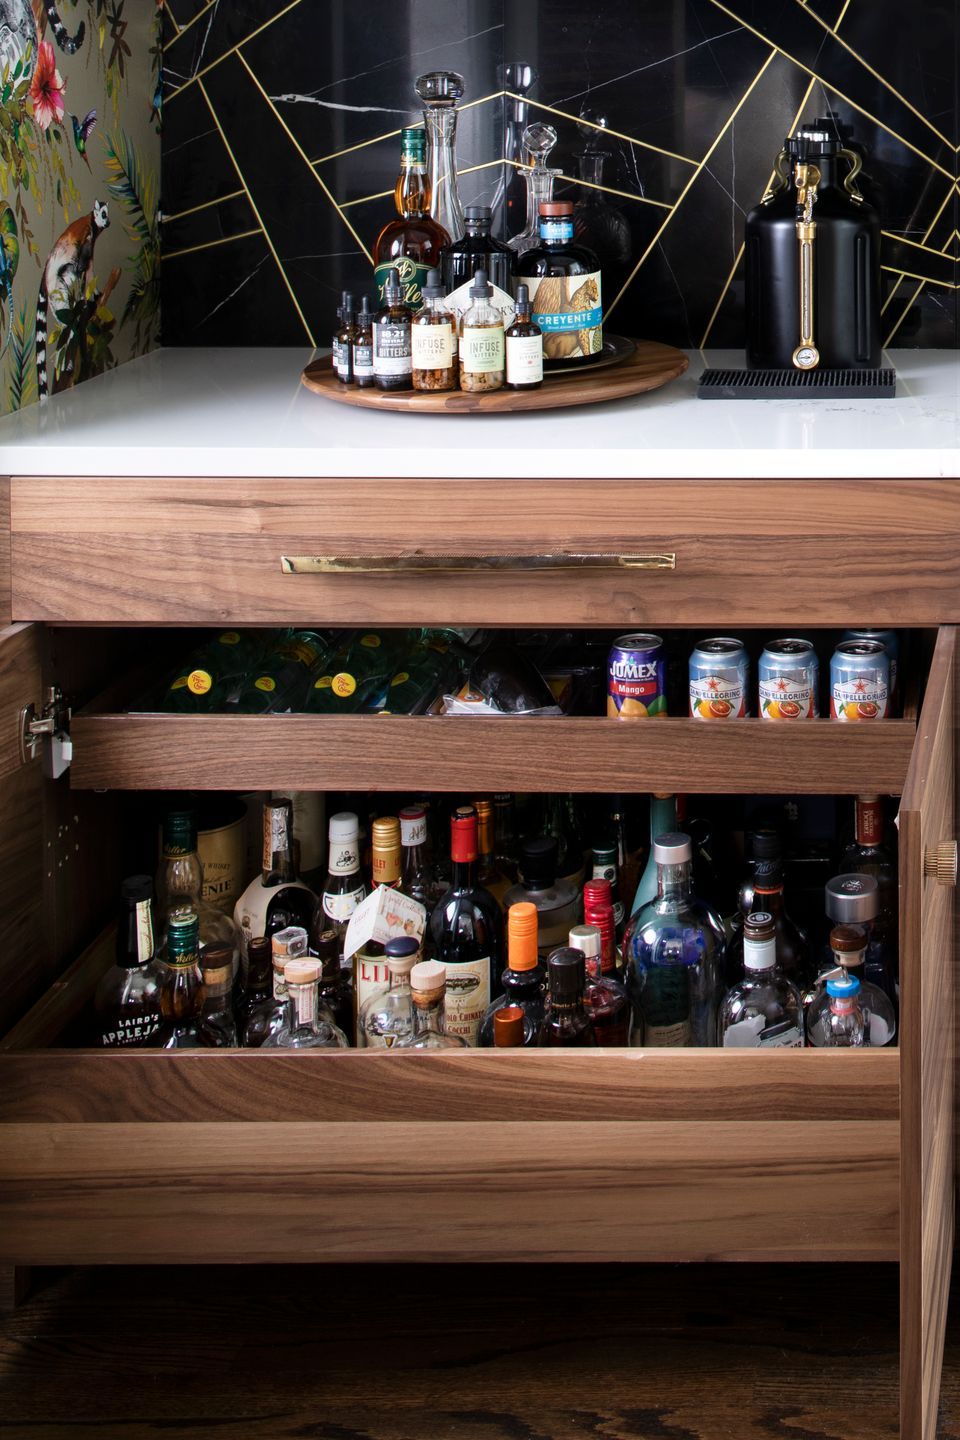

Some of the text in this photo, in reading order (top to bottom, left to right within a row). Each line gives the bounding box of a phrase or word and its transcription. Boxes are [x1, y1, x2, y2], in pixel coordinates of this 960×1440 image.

[537, 312, 592, 325] CREYENTE
[379, 347, 408, 357] BITTERS
[469, 341, 501, 353] INFUSE
[618, 684, 645, 694] Mango
[118, 1013, 159, 1028] LAIRD'S
